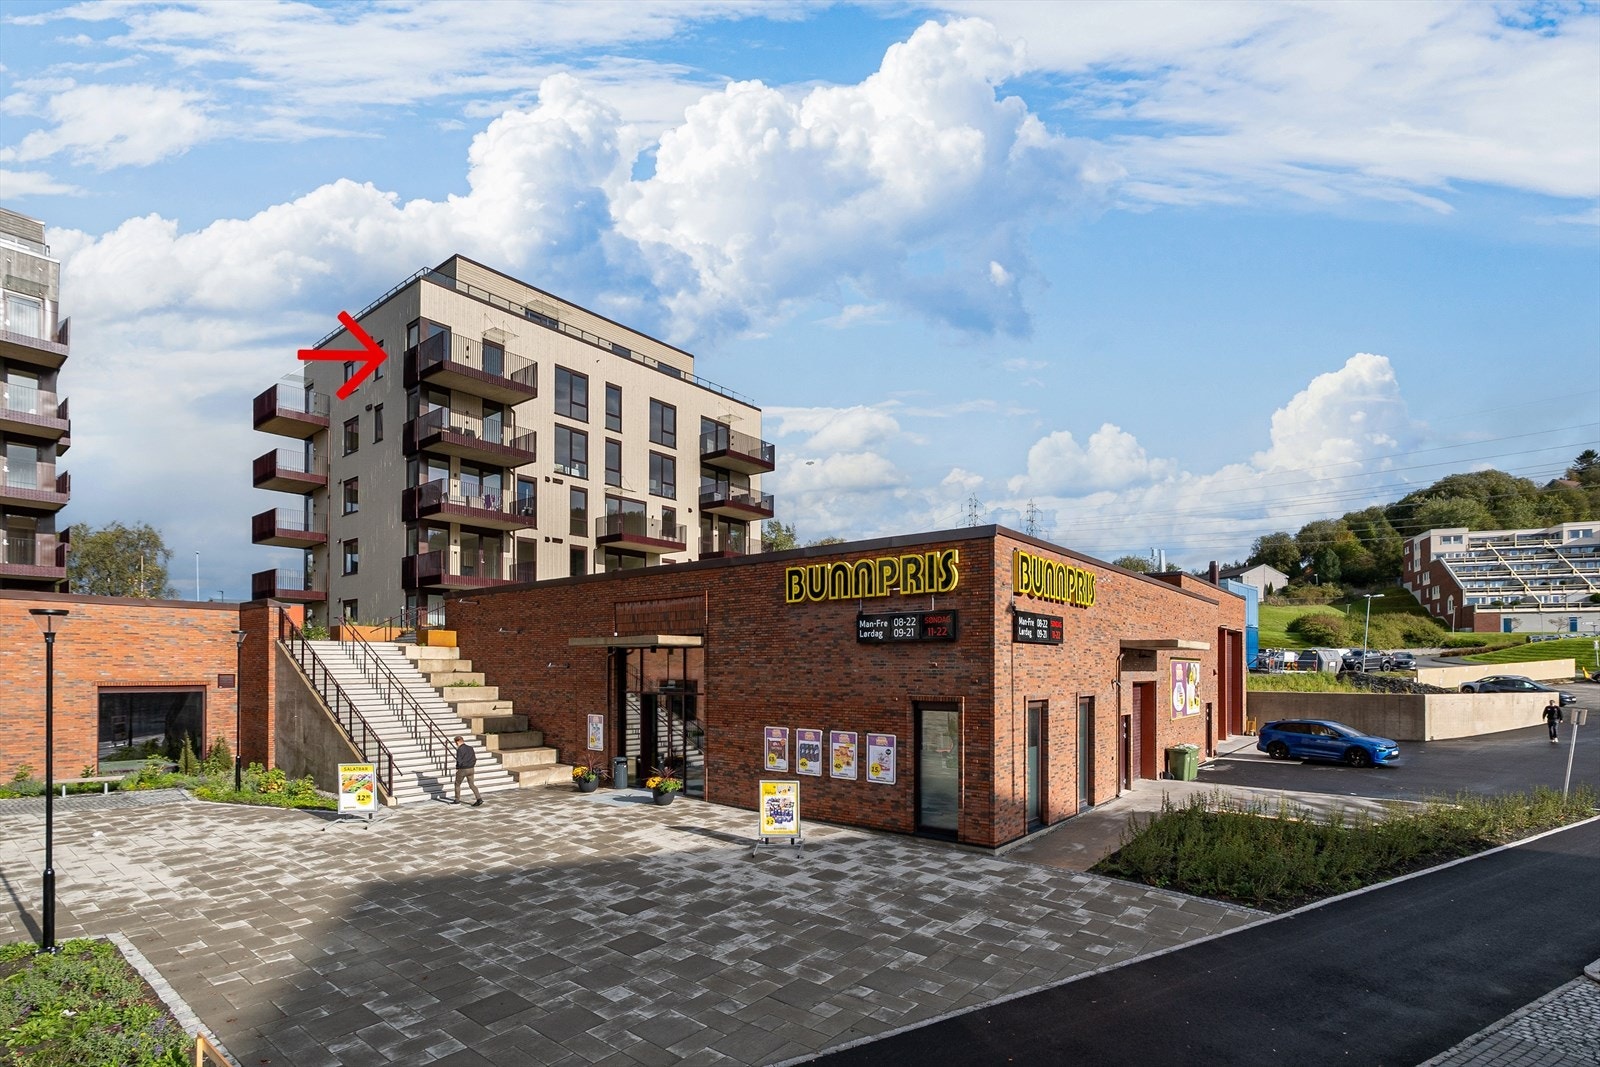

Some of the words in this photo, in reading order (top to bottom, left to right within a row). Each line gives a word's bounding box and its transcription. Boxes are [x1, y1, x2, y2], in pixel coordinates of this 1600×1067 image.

[786, 549, 959, 603] BUNNPRIS
[1018, 550, 1096, 607] BUNNPRIS
[859, 619, 888, 628] Man-Fre
[893, 617, 916, 627] 08-22
[859, 629, 883, 639] Lørdag
[893, 628, 914, 637] 09-21
[927, 627, 947, 636] 11-22
